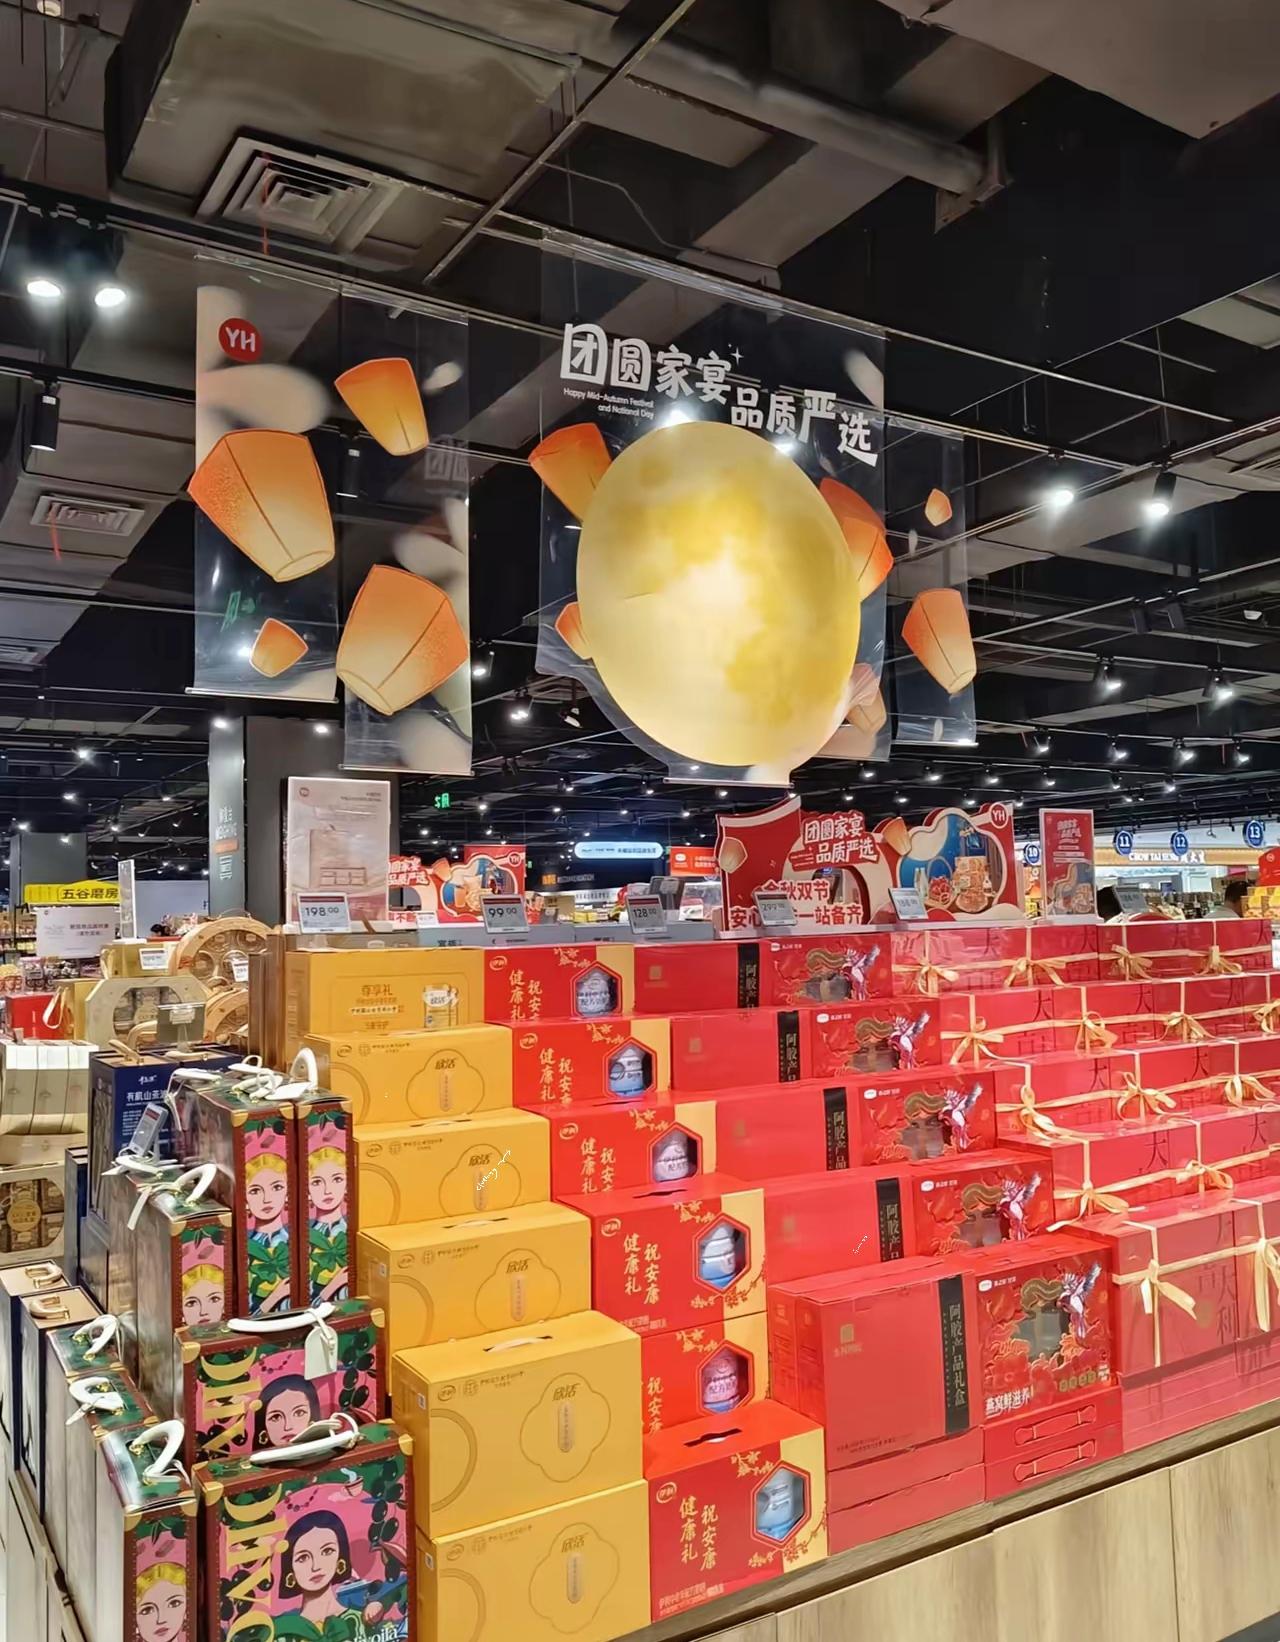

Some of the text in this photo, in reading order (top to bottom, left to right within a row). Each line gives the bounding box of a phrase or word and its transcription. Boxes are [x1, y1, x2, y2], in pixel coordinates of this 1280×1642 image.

[225, 327, 256, 352] YH
[560, 323, 732, 405] 团圆家宴
[563, 387, 586, 400] Happy
[597, 404, 612, 412] and
[640, 409, 654, 420] Day
[731, 388, 878, 467] 品质严选
[804, 815, 864, 844] 团圆家宴
[993, 809, 1005, 821] YH
[1250, 826, 1261, 838] 13
[815, 838, 877, 864] 品质严选
[1119, 836, 1130, 847] 11
[1175, 836, 1186, 847] 12
[62, 888, 119, 900] 五谷磨房
[509, 969, 526, 1021] 健康礼
[539, 1048, 556, 1102] 健康礼
[581, 1137, 598, 1194] 健康礼
[623, 1233, 641, 1296] 健康礼
[643, 1243, 661, 1305] 祝安康
[949, 1303, 966, 1407] 阿胶产品礼盒
[679, 1496, 698, 1565] 健康礼
[700, 1504, 719, 1572] 祝安康
